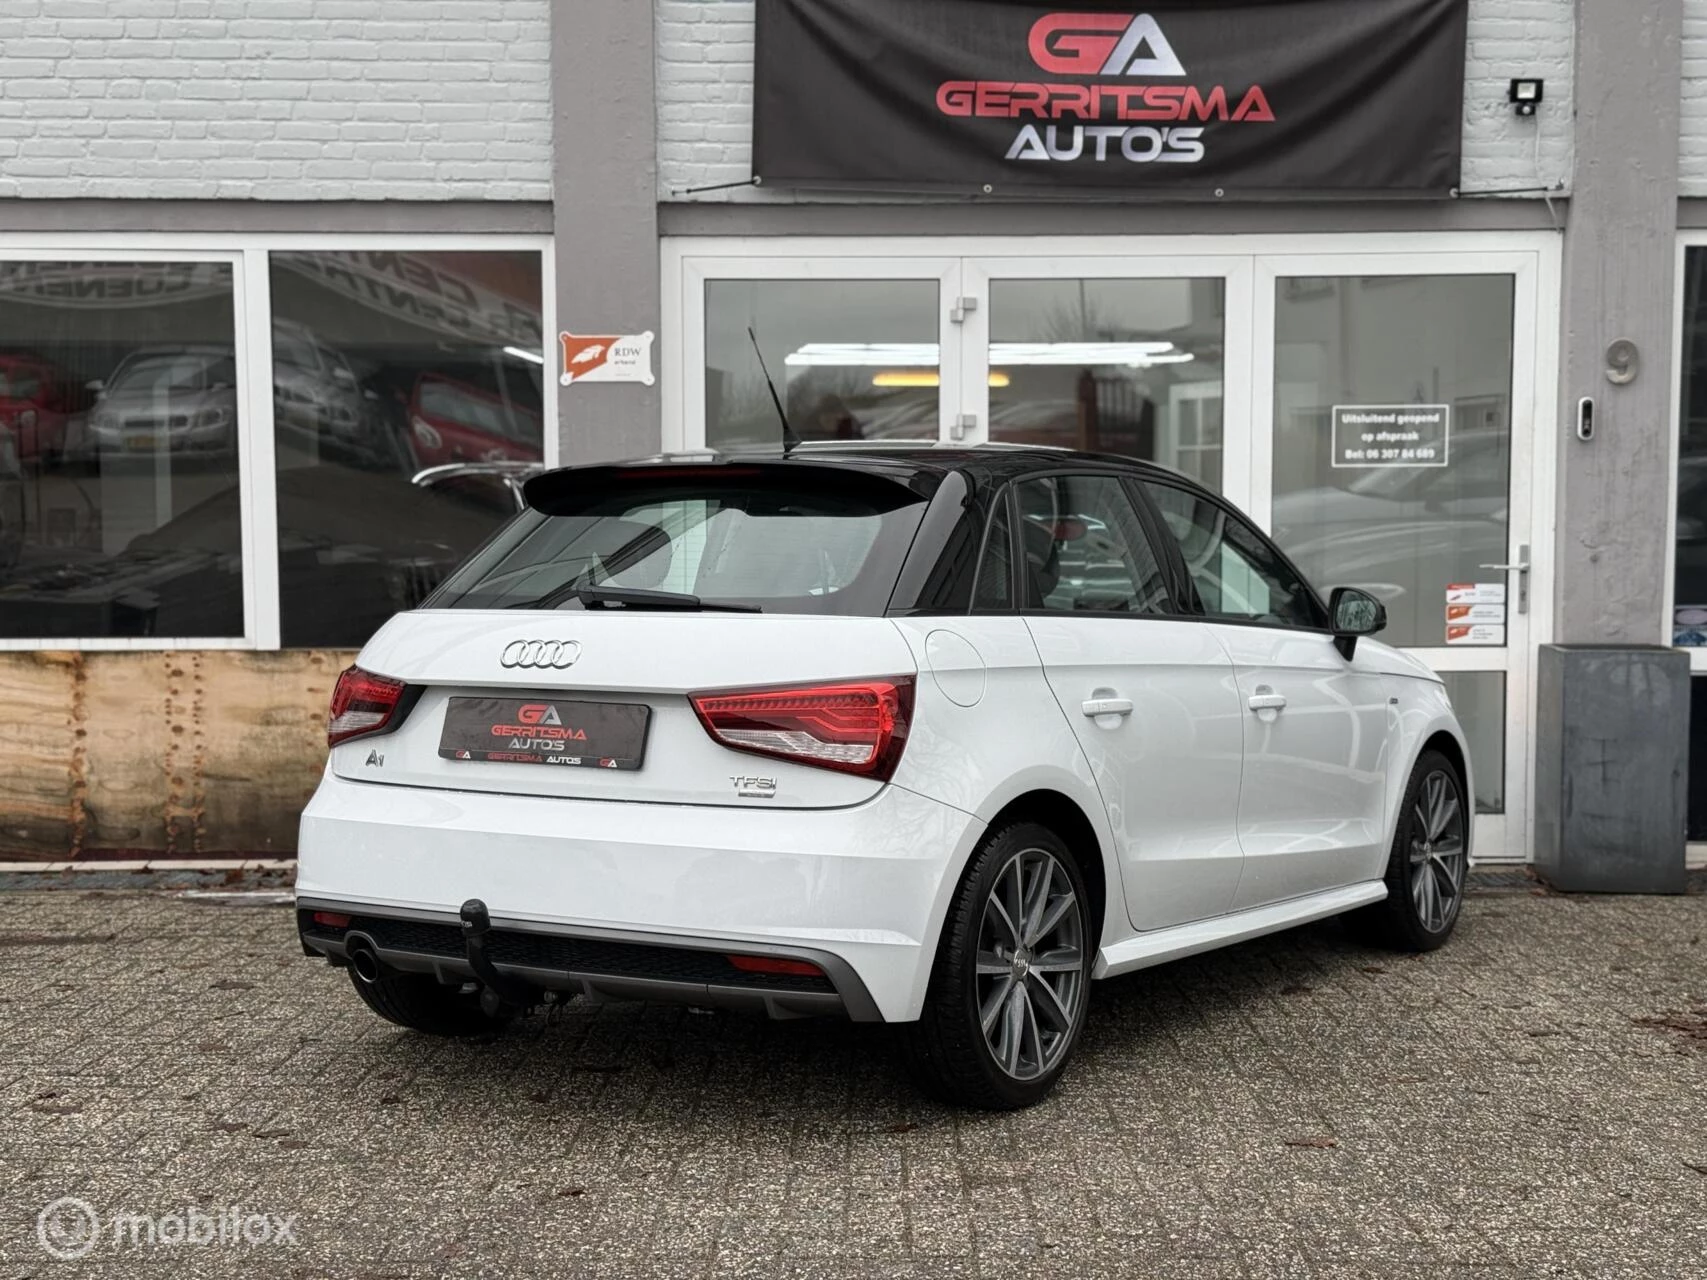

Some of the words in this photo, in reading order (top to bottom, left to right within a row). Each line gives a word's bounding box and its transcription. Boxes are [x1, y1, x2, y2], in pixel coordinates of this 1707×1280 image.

[1027, 12, 1187, 76] GA
[936, 80, 1276, 122] GERRITSMA
[1004, 124, 1205, 163] AUTO'S
[614, 347, 642, 357] RDW
[1605, 339, 1639, 384] 9
[1366, 449, 1379, 459] 06
[518, 704, 562, 725] GA
[491, 724, 587, 740] GERRITSMA
[487, 752, 543, 763] GERRITSMA
